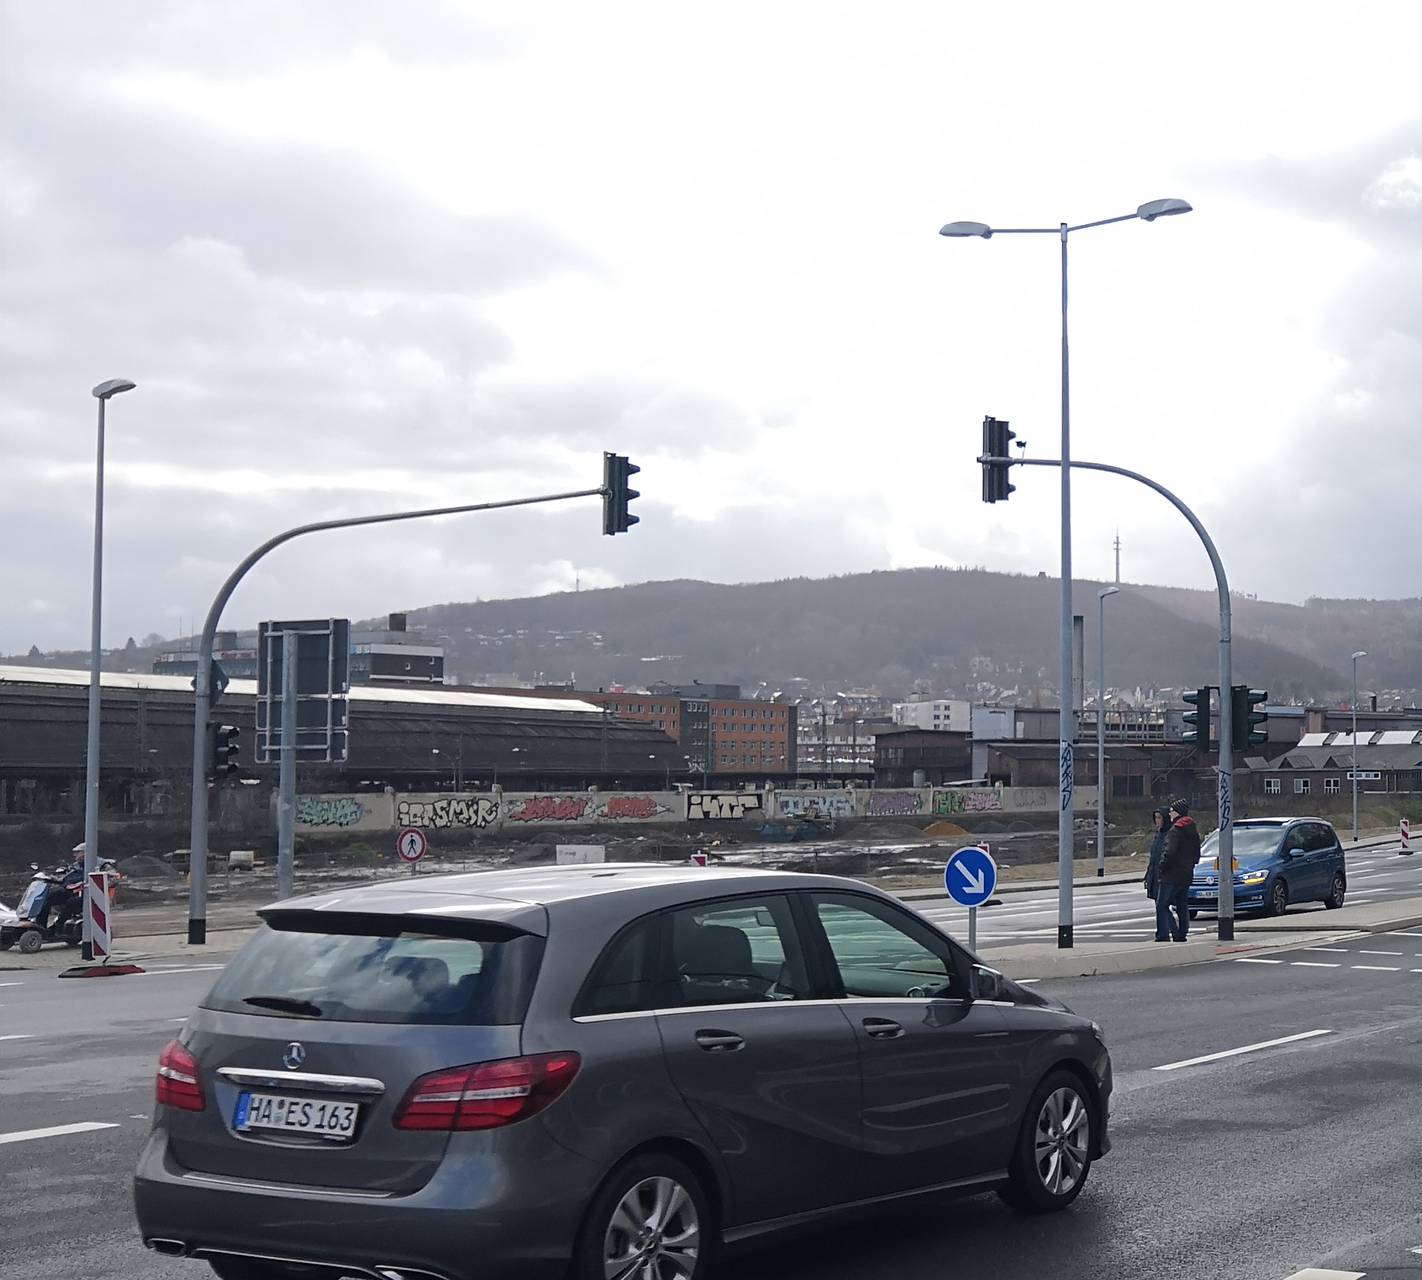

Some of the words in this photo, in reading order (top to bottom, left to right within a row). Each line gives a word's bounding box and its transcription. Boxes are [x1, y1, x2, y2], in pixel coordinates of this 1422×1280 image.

[249, 1098, 273, 1123] HA
[285, 1101, 314, 1127] ES
[314, 1104, 355, 1131] 163
